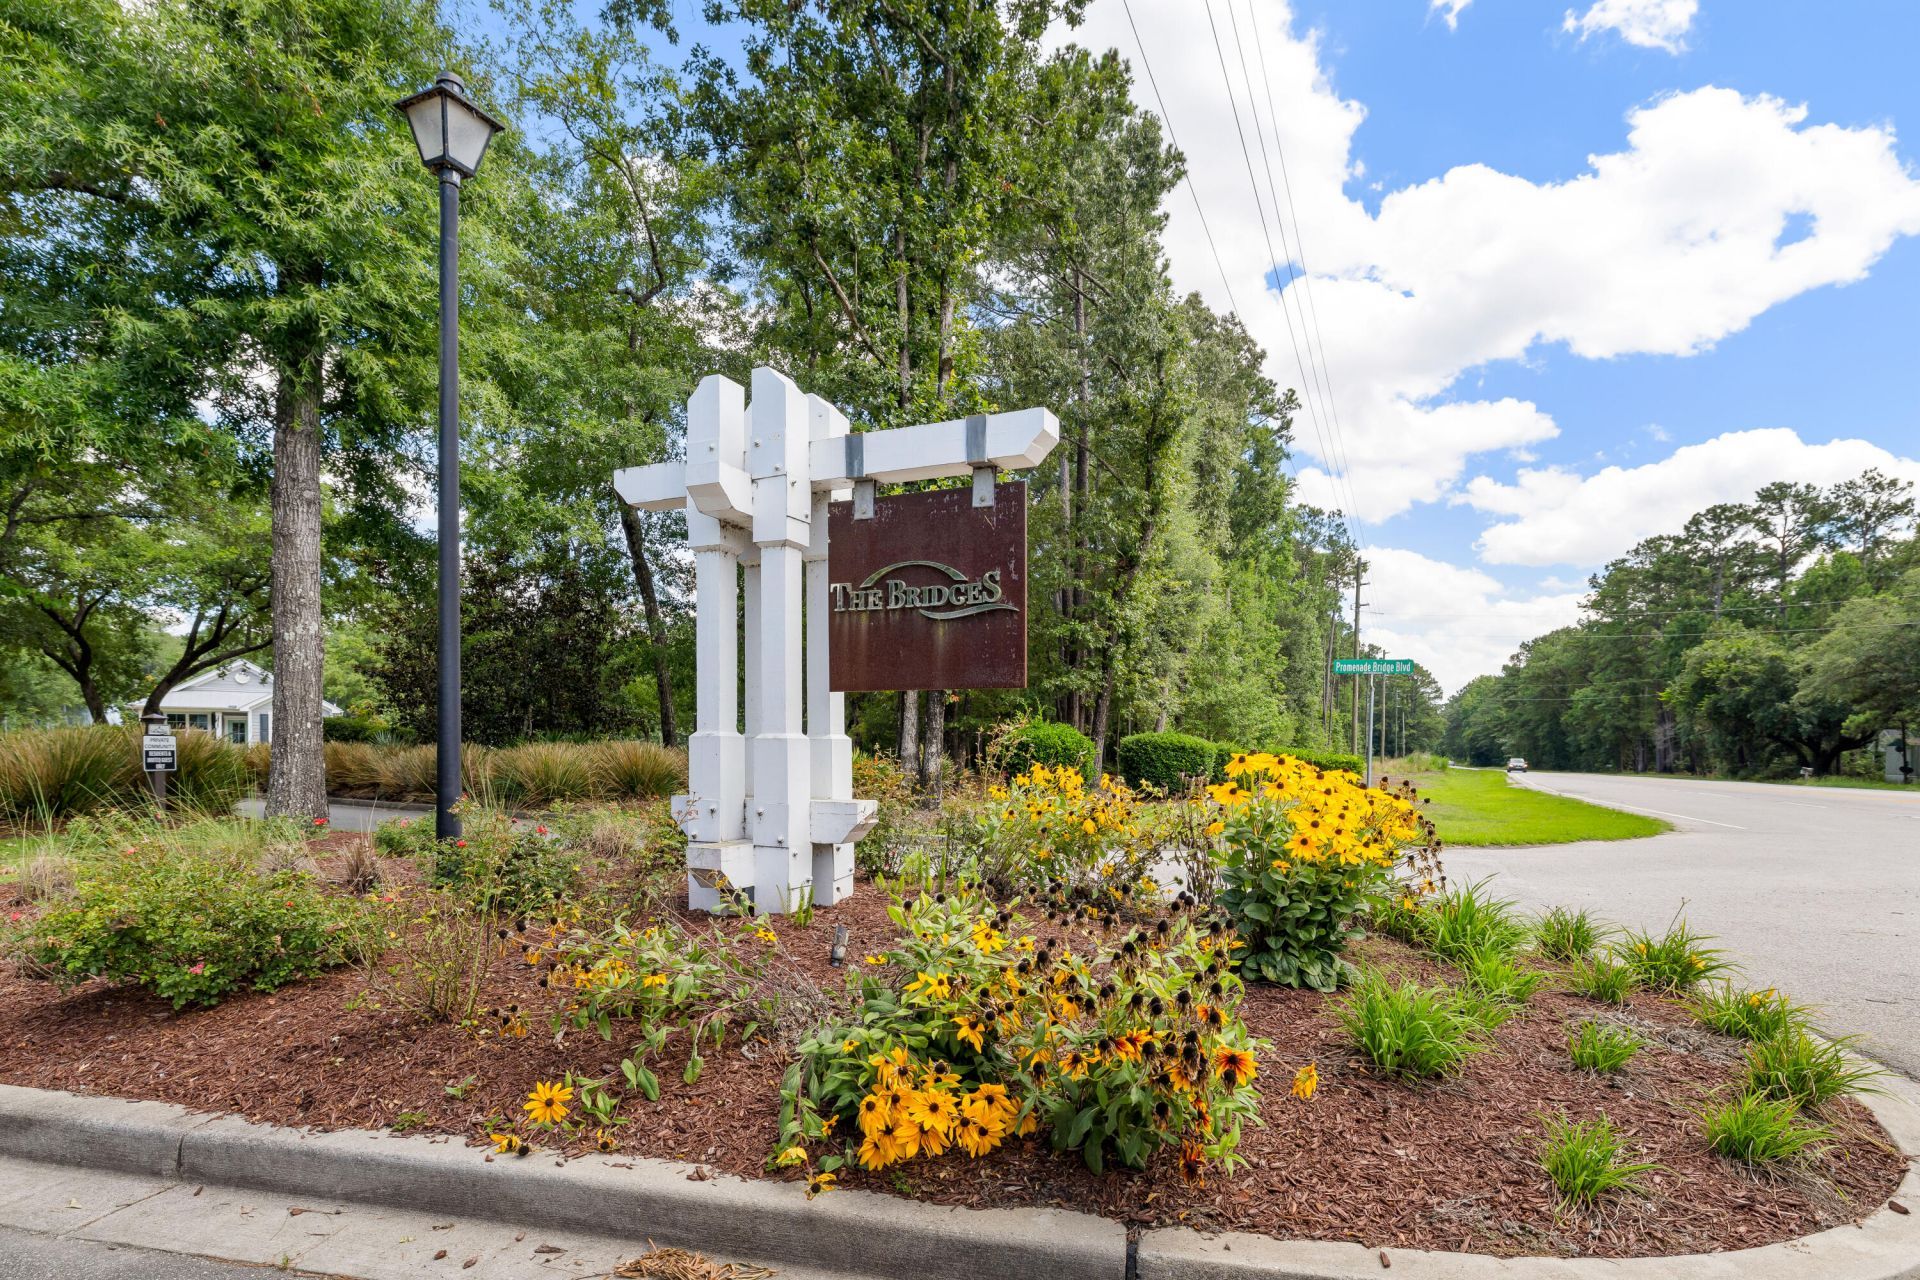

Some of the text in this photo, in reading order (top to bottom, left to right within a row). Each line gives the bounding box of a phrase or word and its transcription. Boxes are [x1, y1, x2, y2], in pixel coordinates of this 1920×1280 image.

[830, 571, 1002, 612] THE BRIDGES
[1336, 661, 1411, 673] Promenade Bridge Blvd
